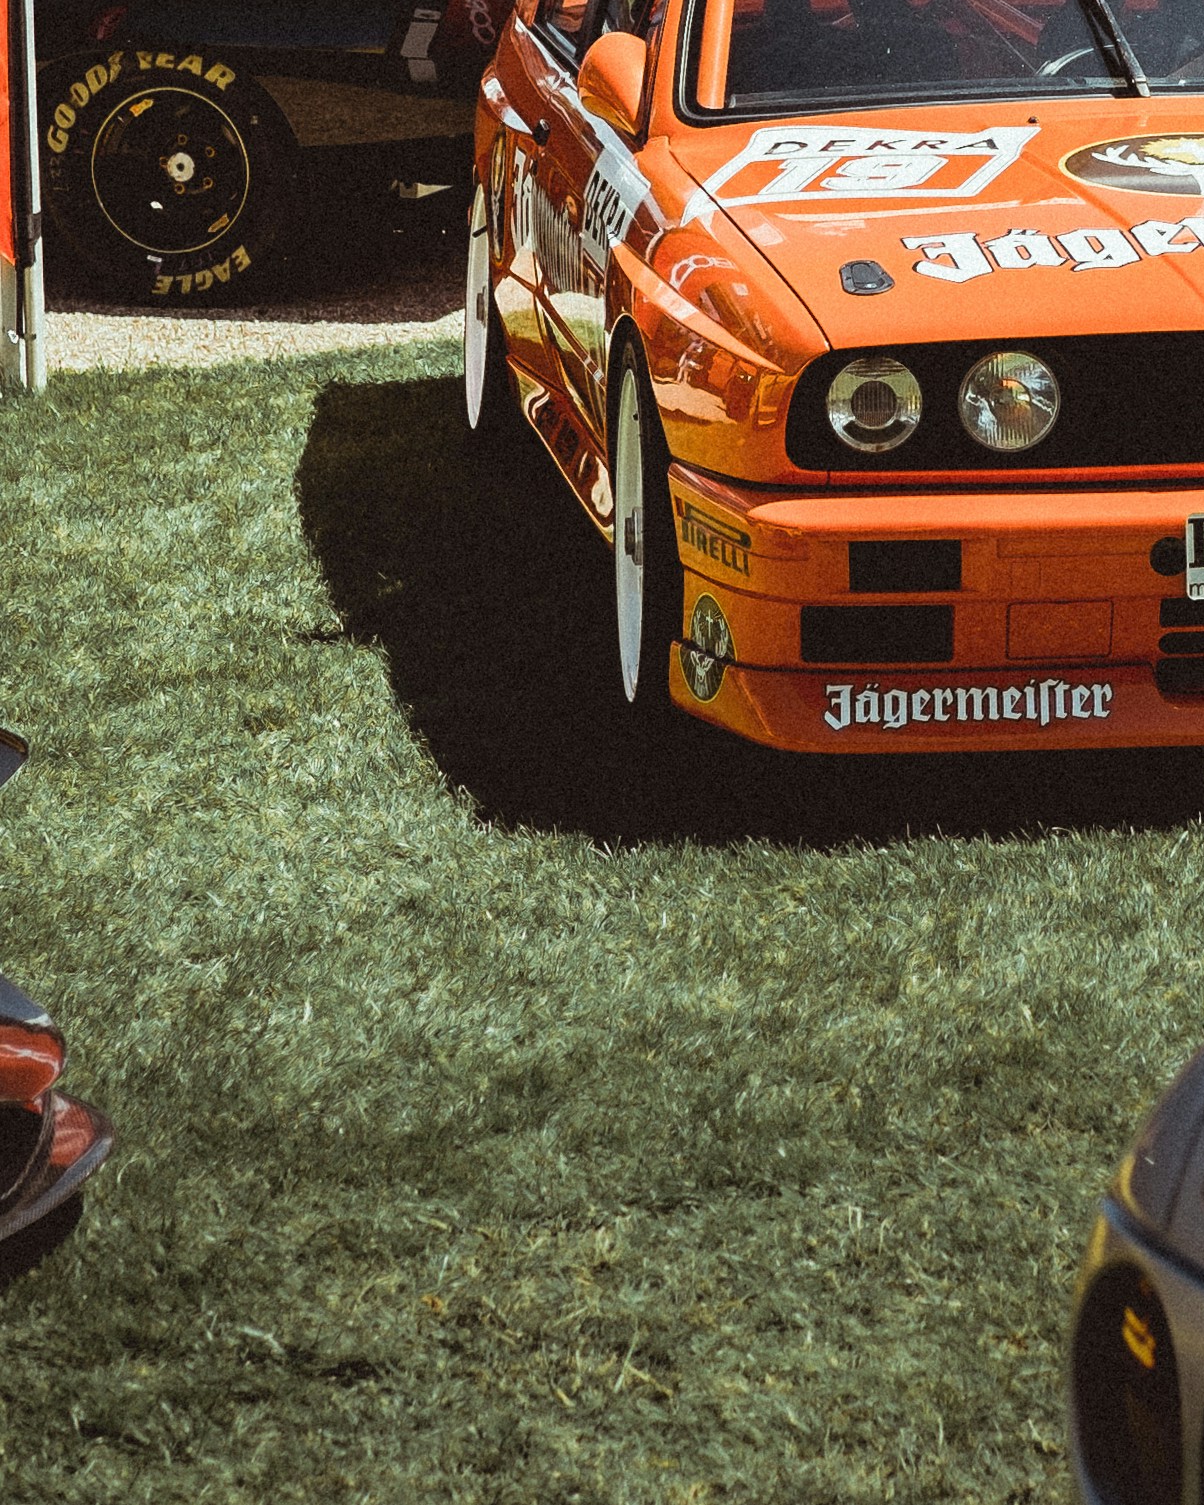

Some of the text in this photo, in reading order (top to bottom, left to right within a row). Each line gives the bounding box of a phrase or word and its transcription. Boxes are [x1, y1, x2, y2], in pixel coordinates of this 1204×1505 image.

[763, 138, 1001, 156] DEKRA
[151, 244, 252, 296] EAGLE
[682, 501, 751, 577] PIRELLI
